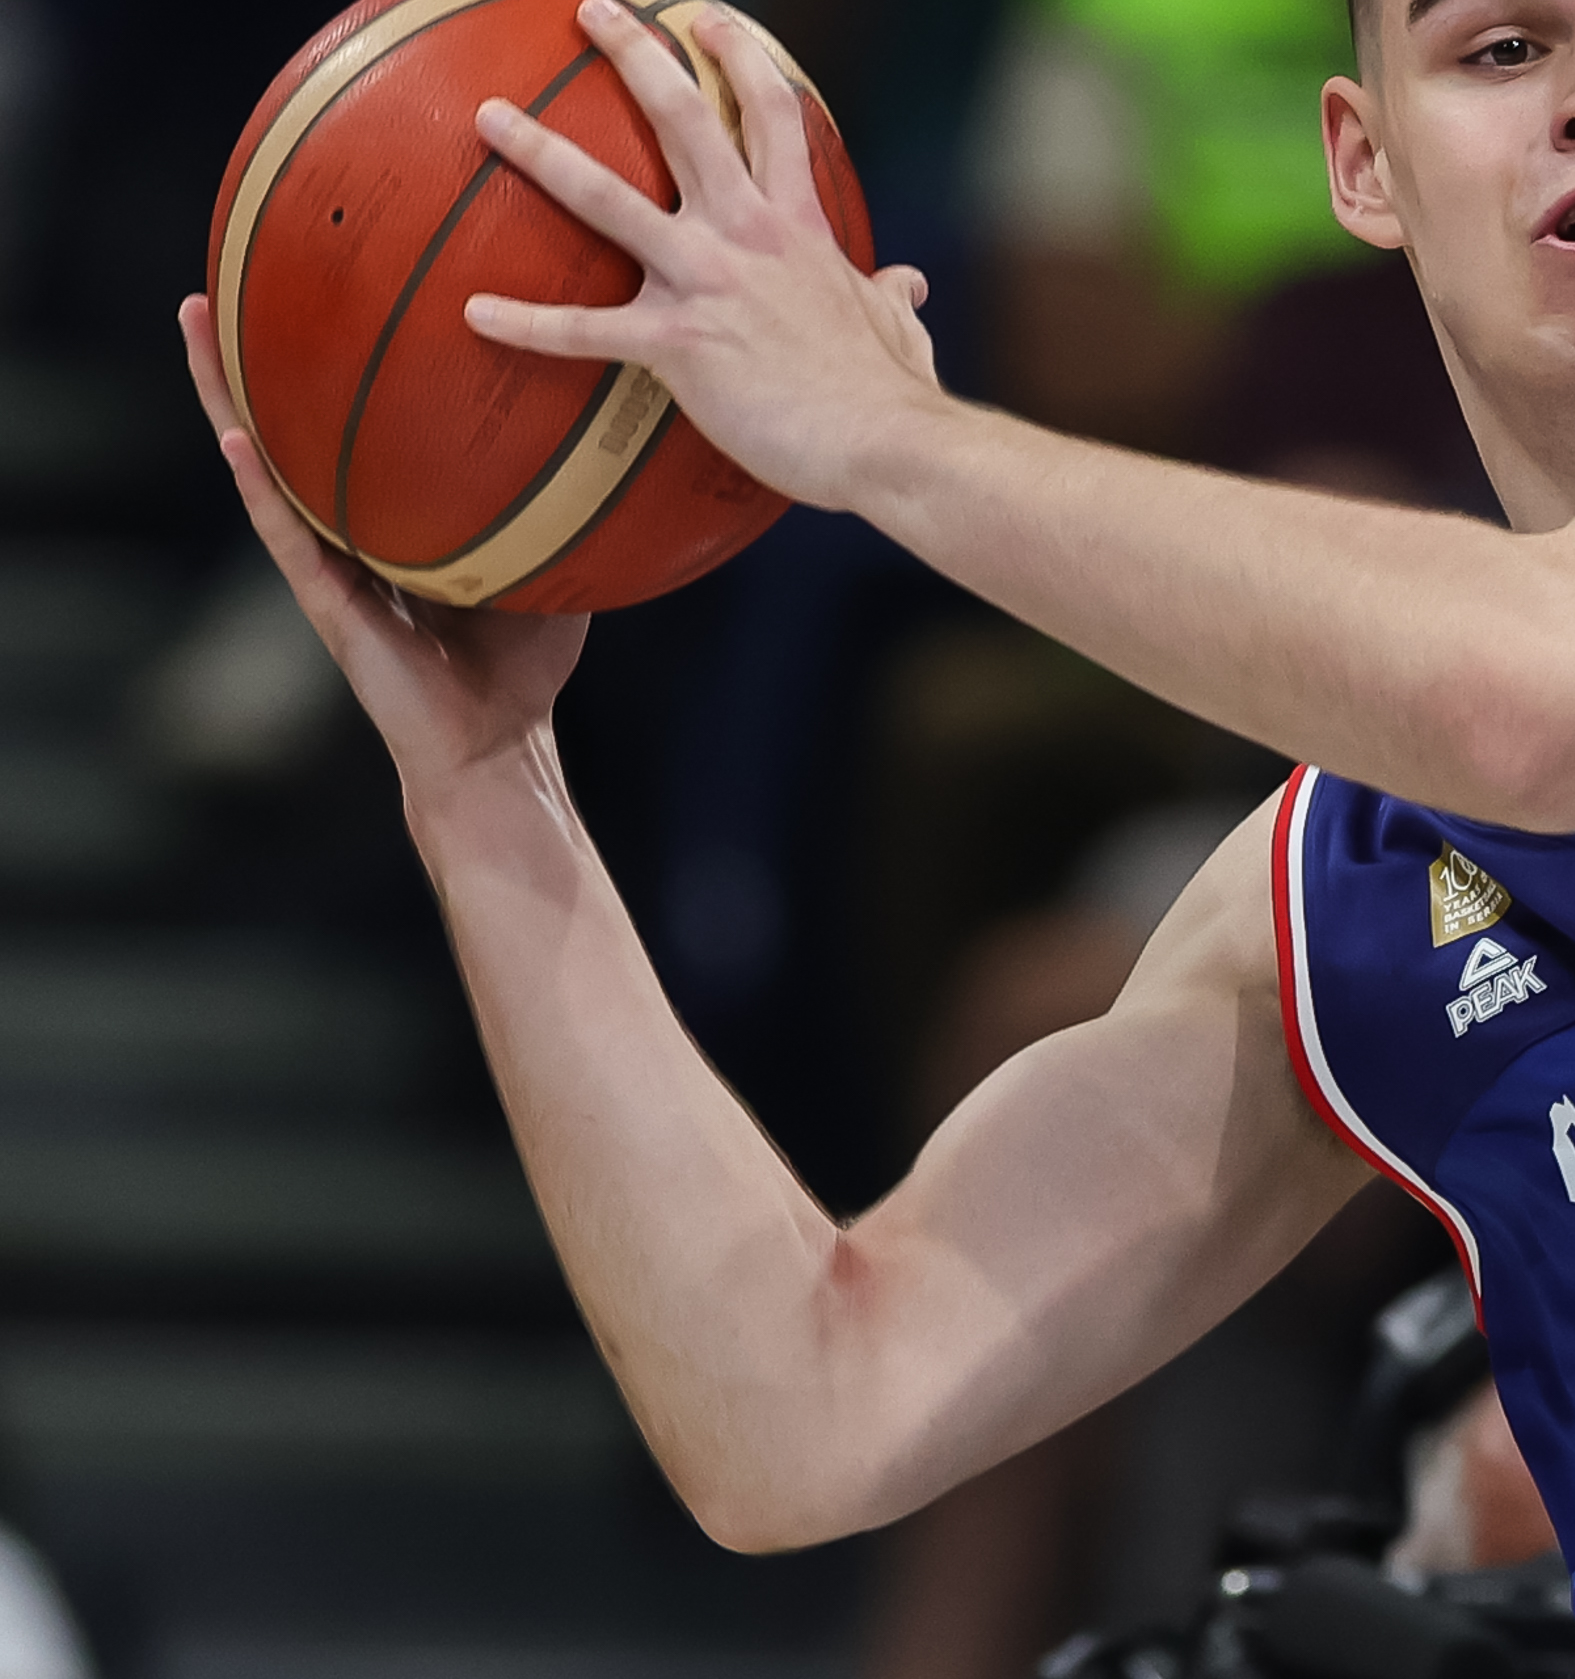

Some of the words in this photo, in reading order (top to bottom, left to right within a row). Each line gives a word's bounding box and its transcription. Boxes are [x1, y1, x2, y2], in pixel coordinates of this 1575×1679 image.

[1443, 883, 1482, 912] YEARS
[1444, 921, 1460, 934] IN
[1446, 955, 1547, 1038] PEAK
